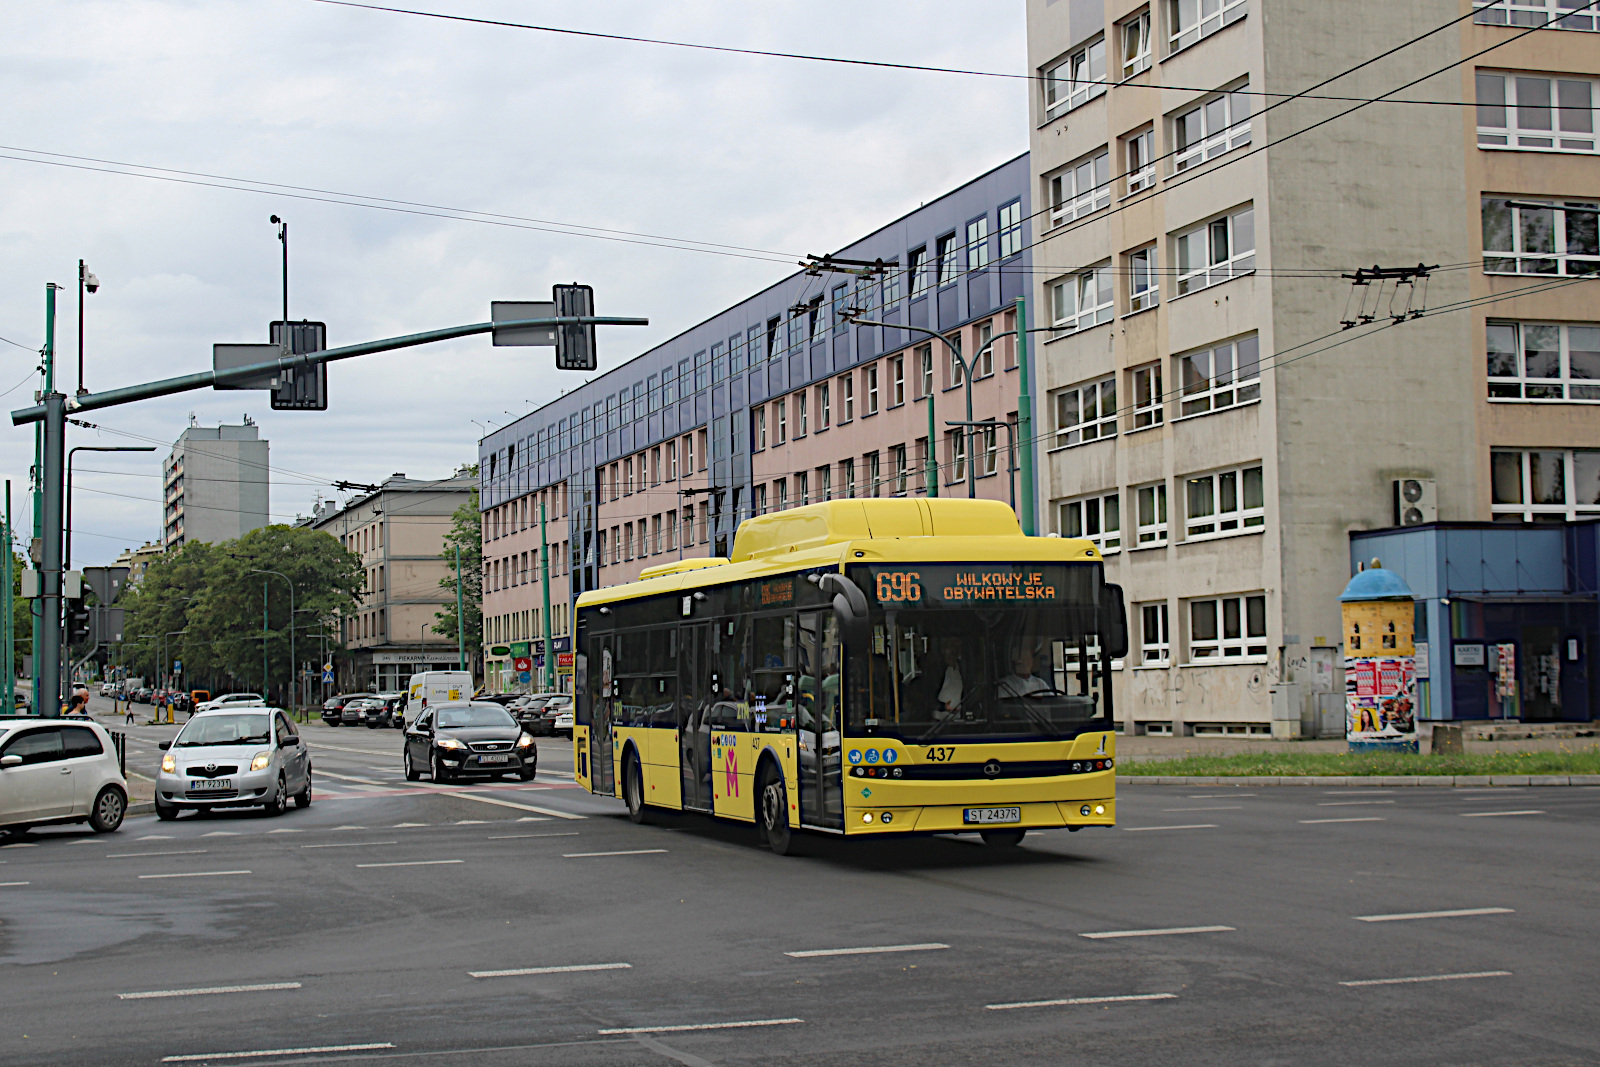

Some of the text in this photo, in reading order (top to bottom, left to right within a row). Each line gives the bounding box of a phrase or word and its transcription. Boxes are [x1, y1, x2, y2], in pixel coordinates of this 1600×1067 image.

[956, 573, 1043, 586] WILKOWYJE
[876, 572, 921, 602] 696
[943, 586, 1056, 600] OBYWATELSKA
[926, 747, 956, 762] 437
[970, 808, 1017, 820] ST 2437R
